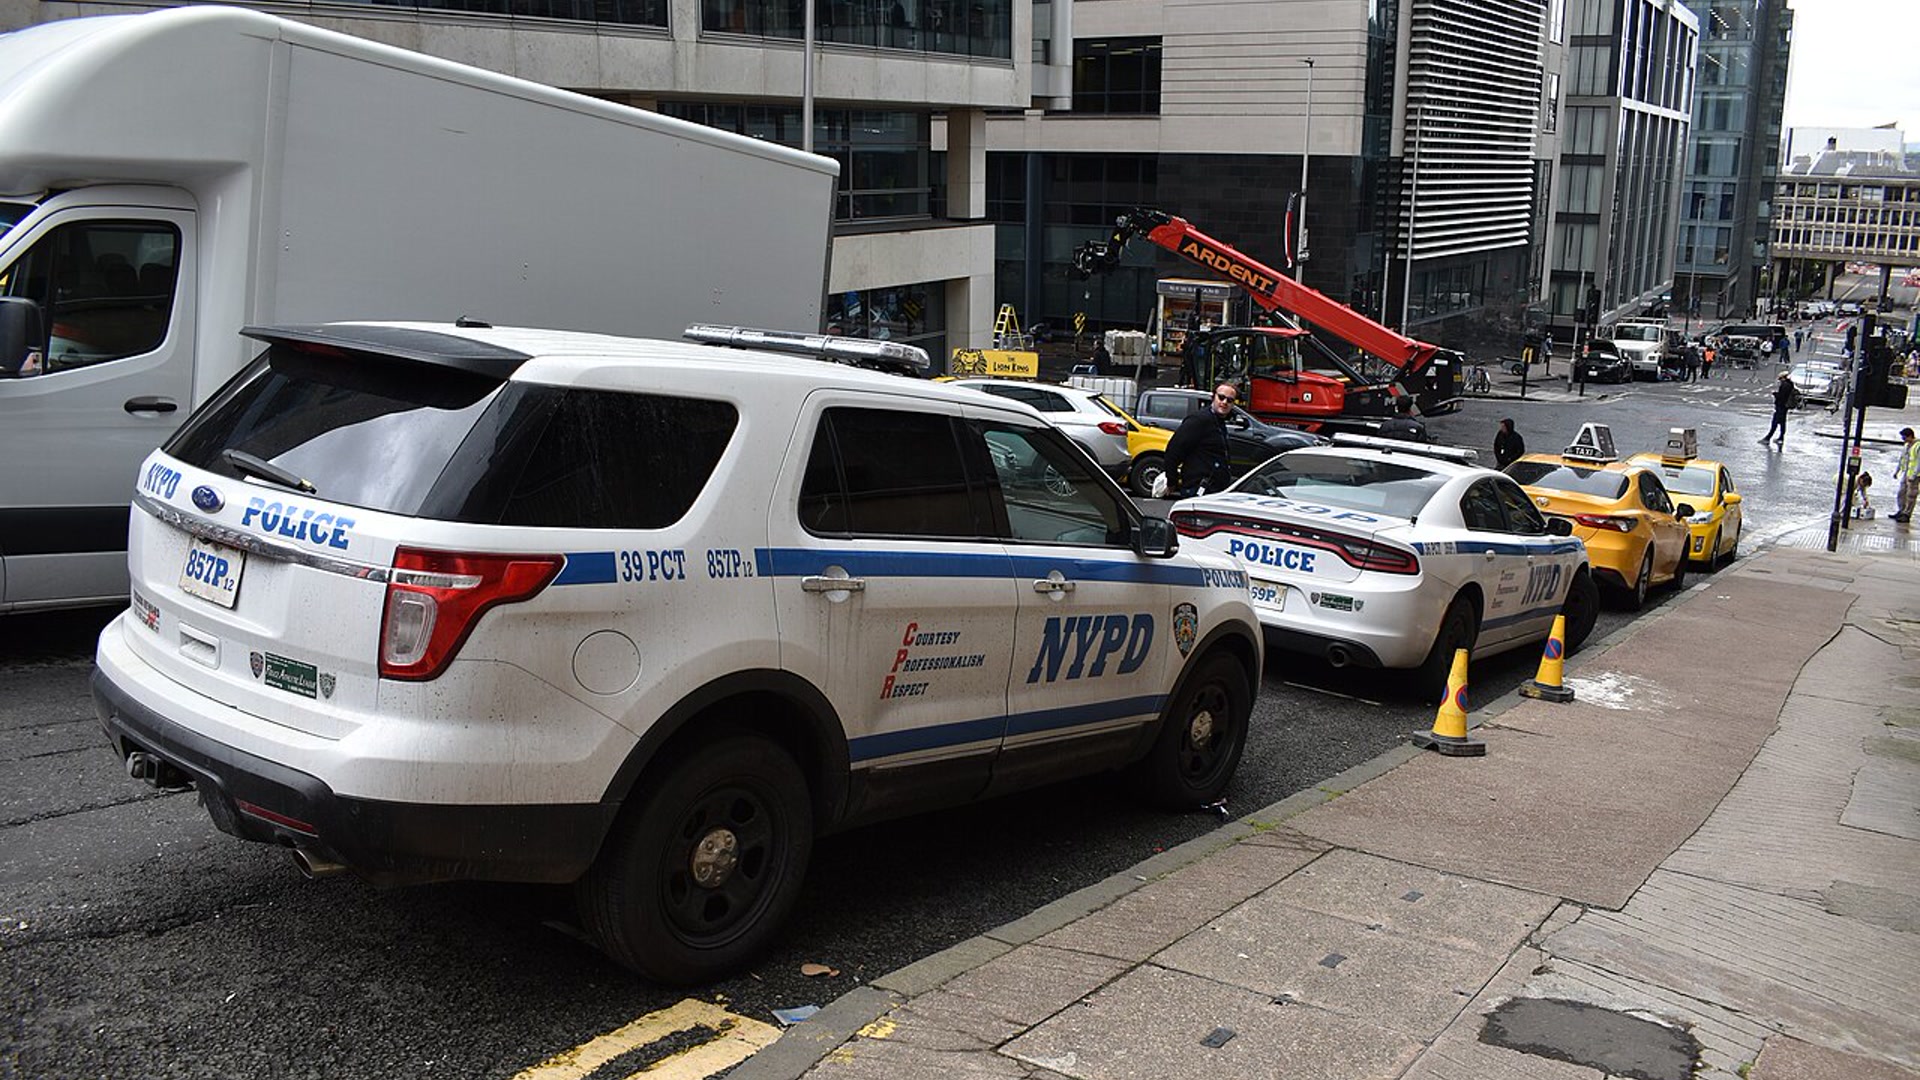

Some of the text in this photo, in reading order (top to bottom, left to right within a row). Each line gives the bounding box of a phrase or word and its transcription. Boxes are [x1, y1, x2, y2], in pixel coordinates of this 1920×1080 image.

[1182, 242, 1273, 291] ARDENT
[993, 361, 1010, 372] LION
[1575, 447, 1594, 456] TAXI
[144, 462, 182, 500] NYPD
[241, 497, 355, 550] POLICE
[186, 549, 229, 587] 857P
[621, 550, 686, 582] 39 PCT
[707, 549, 741, 579] 857P
[1229, 539, 1316, 573] POLICE
[1520, 564, 1561, 605] NYPD
[903, 623, 960, 646] COURTESY
[1026, 613, 1154, 684] NYPD
[892, 649, 985, 673] PROFESSIONALISM
[880, 675, 929, 699] RESPECT
